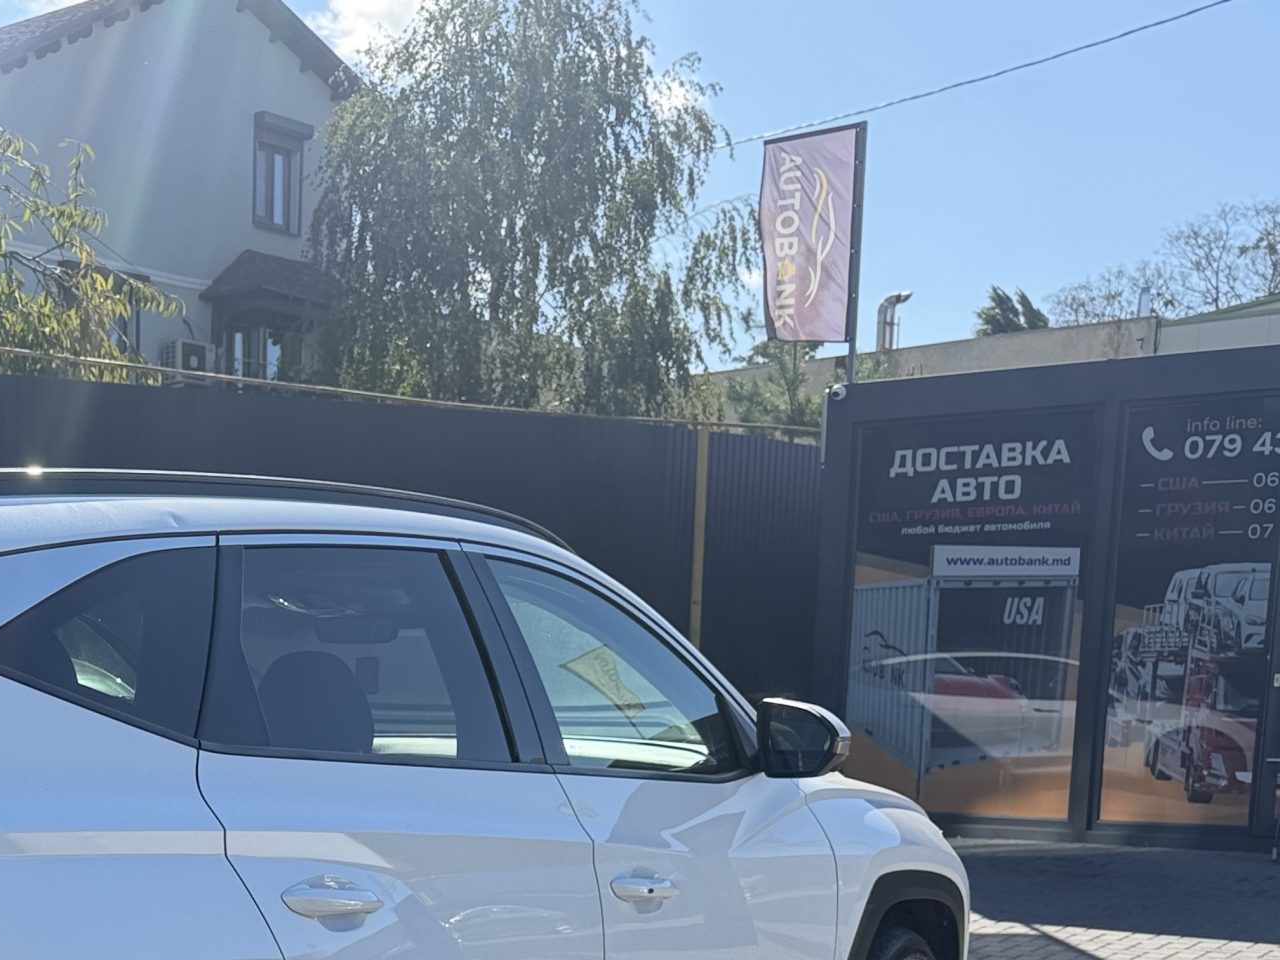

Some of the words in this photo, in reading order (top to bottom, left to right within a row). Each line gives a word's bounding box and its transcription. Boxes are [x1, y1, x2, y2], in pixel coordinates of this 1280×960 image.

[1186, 417, 1221, 433] info
[1225, 416, 1263, 431] line:
[1184, 433, 1243, 460] 079
[889, 439, 1071, 478] ДОСТАВКА
[931, 474, 1022, 503] АВТО
[1157, 476, 1200, 492] США
[1253, 472, 1280, 488] 06
[1032, 500, 1081, 515] КИТАЙ
[1155, 501, 1231, 516] ГРУЗИЯ
[1250, 498, 1277, 514] 06
[901, 524, 935, 535] любой
[937, 523, 981, 534] бюджет
[983, 520, 1051, 532] автомобиля
[1153, 523, 1216, 541] КИТАЙ
[1247, 523, 1274, 539] 07
[946, 556, 1072, 567] www.autobank.md
[1002, 597, 1045, 625] USA
